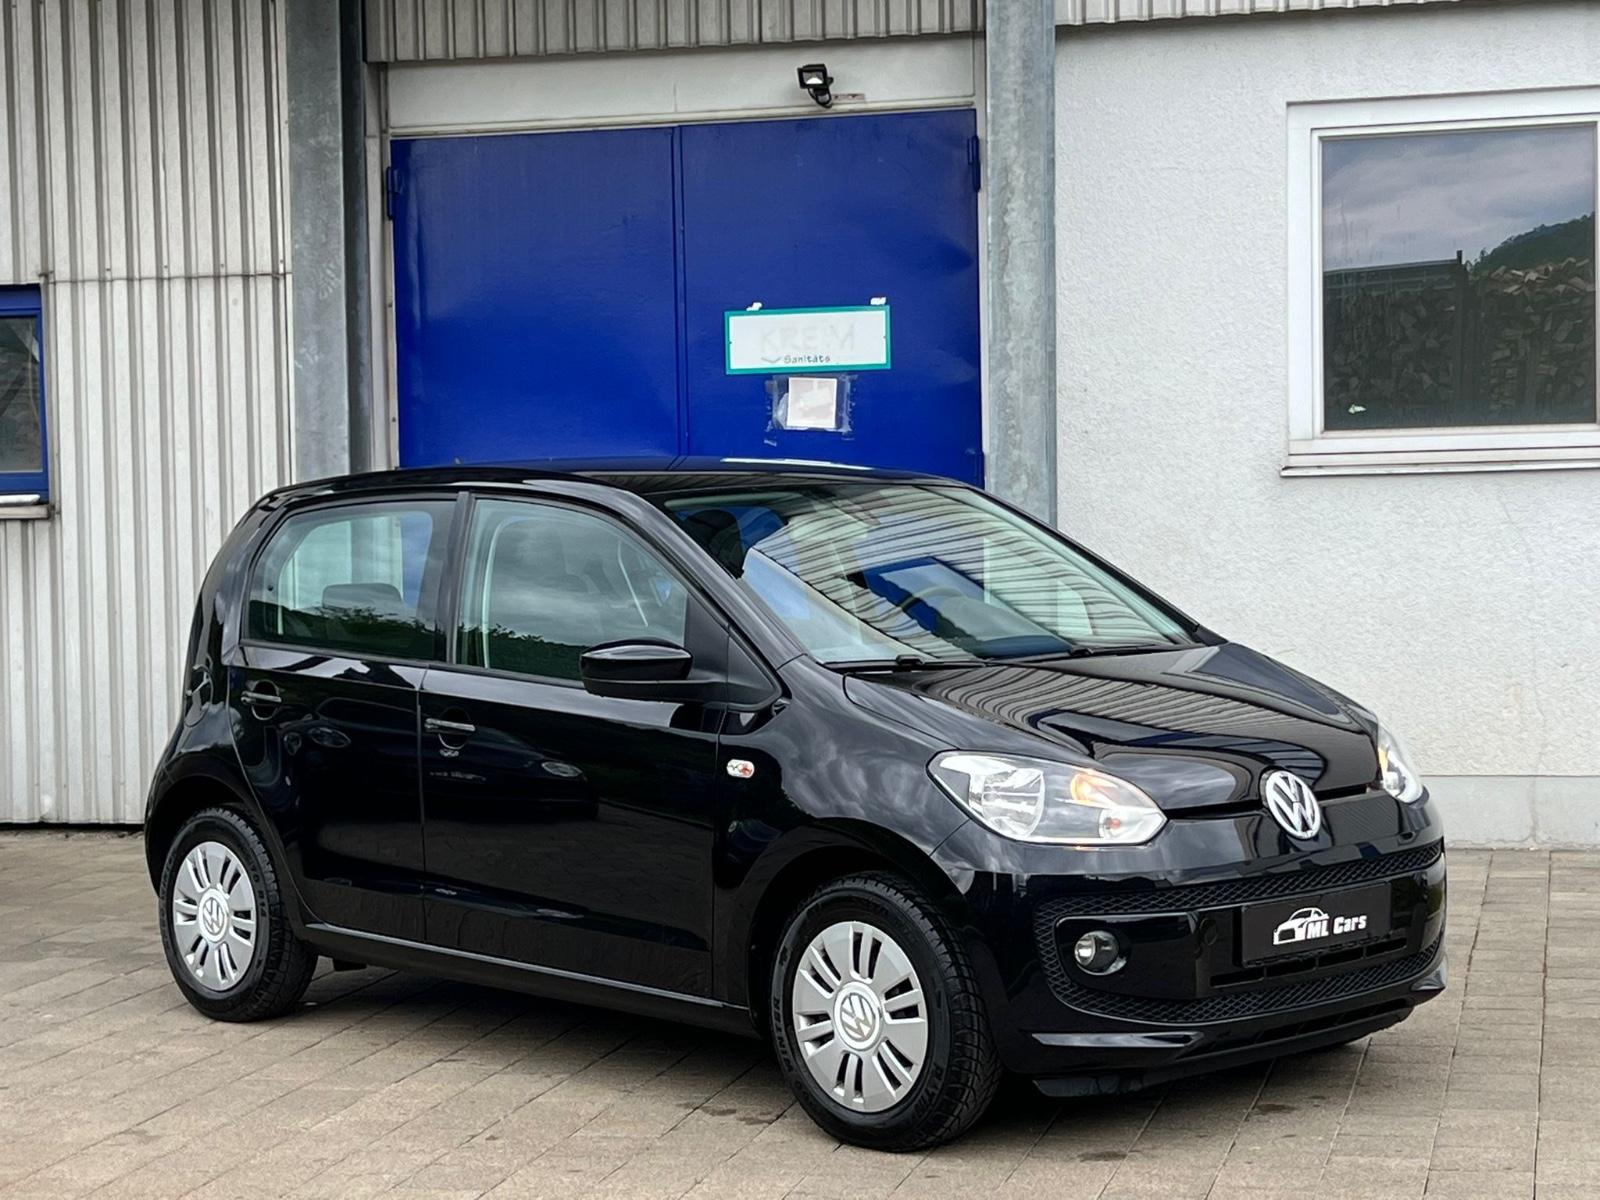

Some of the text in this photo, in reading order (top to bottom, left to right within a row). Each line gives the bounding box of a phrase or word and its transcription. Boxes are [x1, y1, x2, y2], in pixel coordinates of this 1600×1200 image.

[1265, 770, 1321, 840] VW
[202, 896, 226, 936] VW
[1306, 914, 1368, 940] ML Cars
[840, 991, 874, 1041] VW
